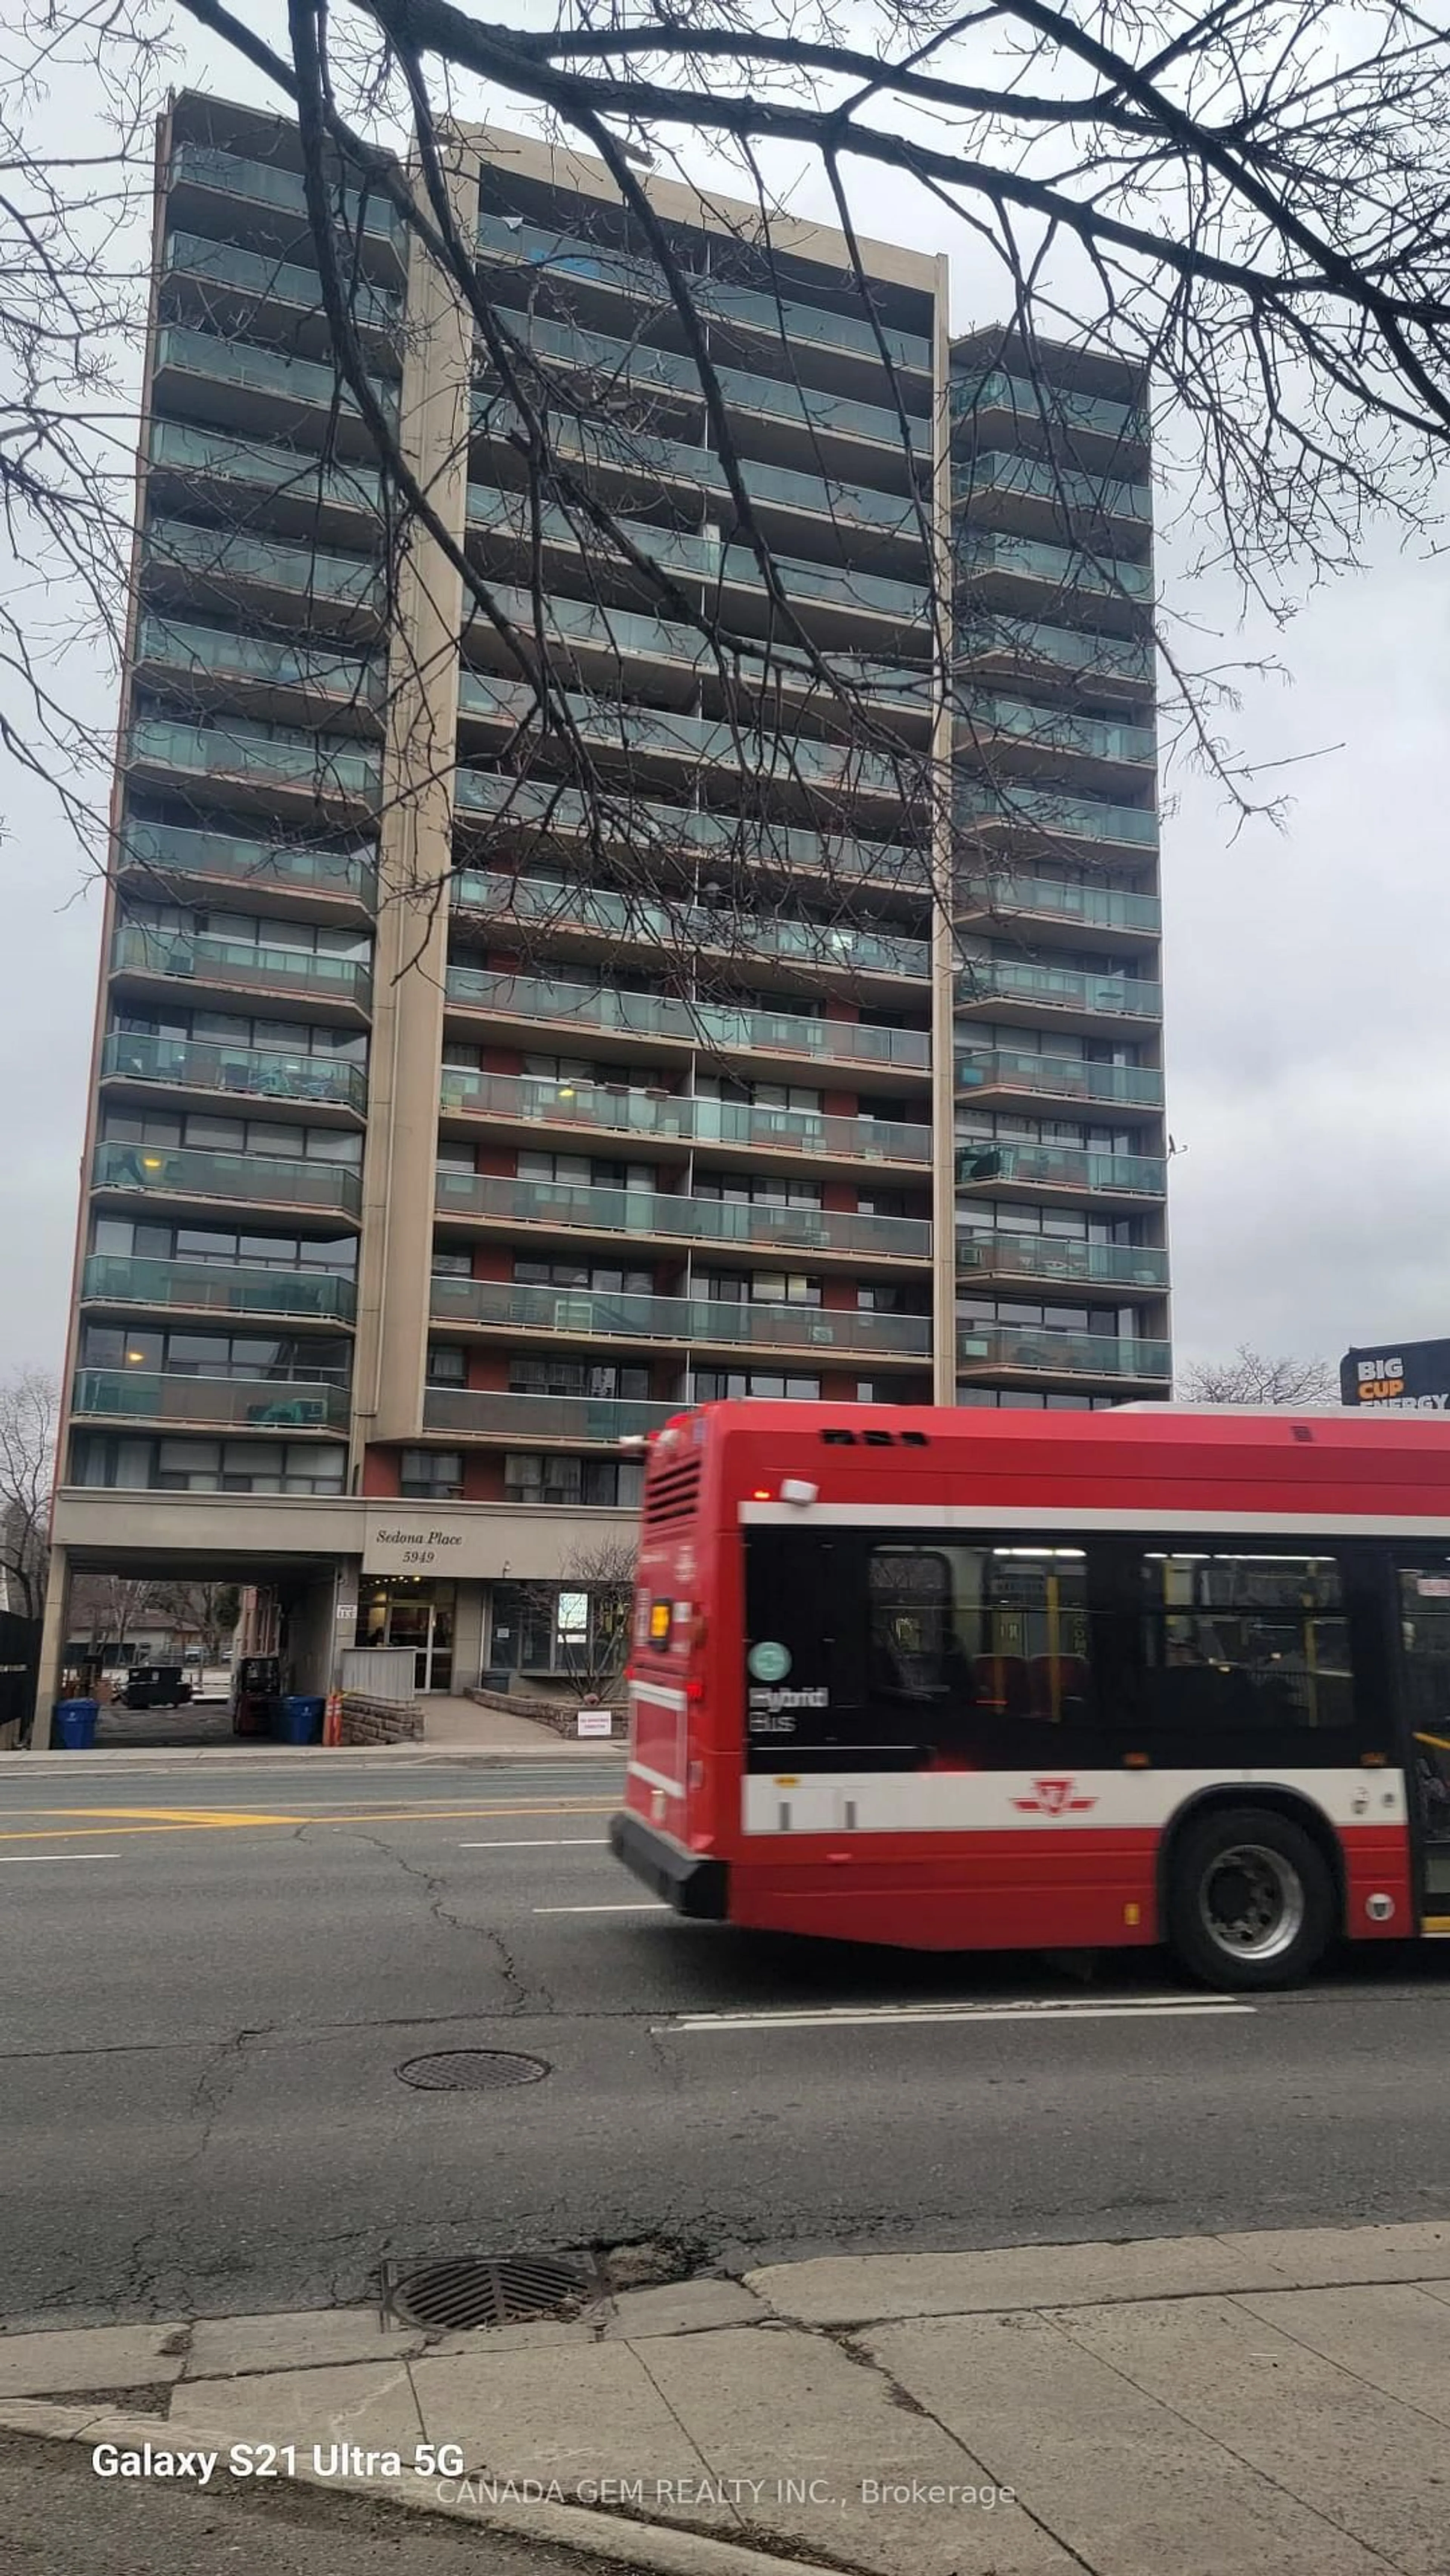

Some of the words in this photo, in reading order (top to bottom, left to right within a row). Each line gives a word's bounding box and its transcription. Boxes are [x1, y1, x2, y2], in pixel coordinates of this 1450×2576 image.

[1358, 1357, 1403, 1381] BIG
[1359, 1380, 1404, 1399] CUP
[1360, 1394, 1448, 1409] ERGY
[376, 1529, 423, 1544] Sedona
[427, 1531, 462, 1545] Place
[402, 1551, 435, 1563] 5949
